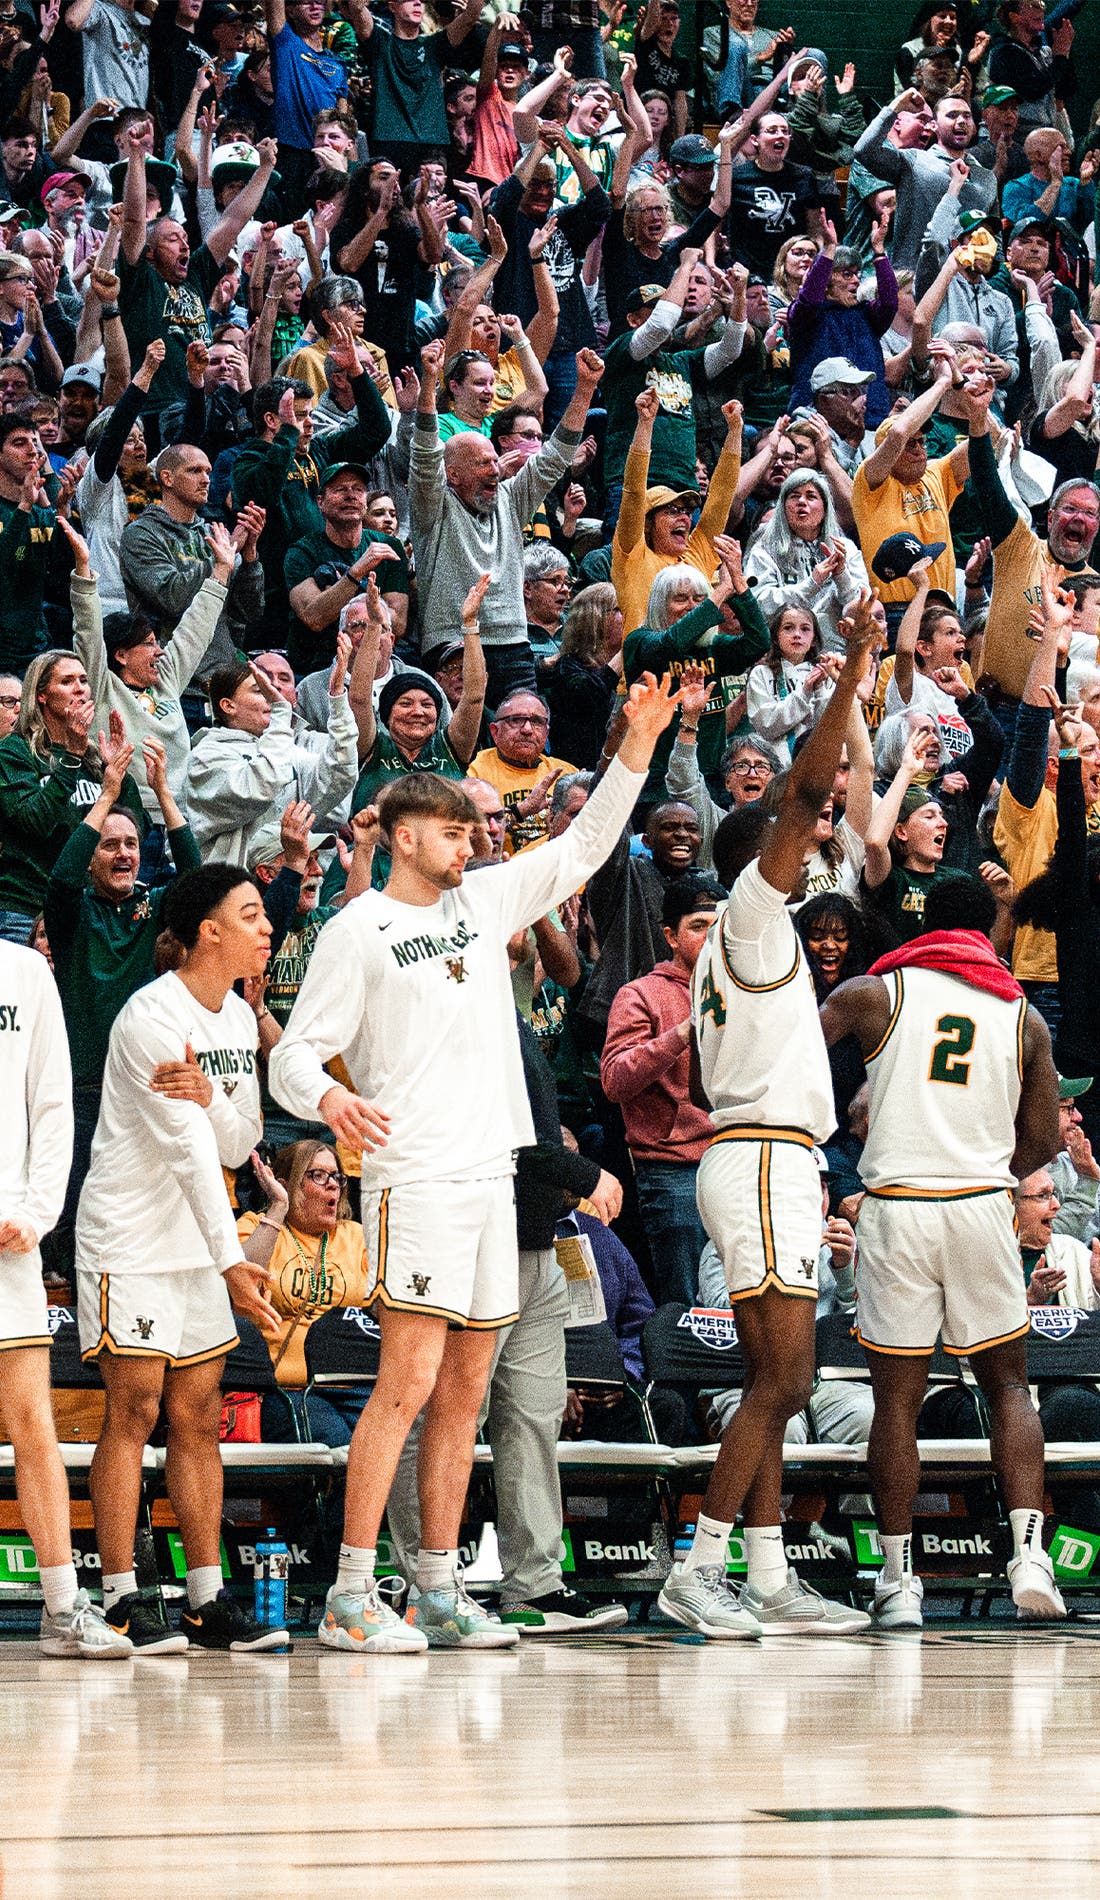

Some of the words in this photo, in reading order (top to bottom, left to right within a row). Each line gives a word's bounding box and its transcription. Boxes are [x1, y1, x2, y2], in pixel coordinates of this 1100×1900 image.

[928, 1012, 976, 1088] 2
[682, 1315, 736, 1330] AMERI
[1029, 1308, 1084, 1319] MERICA
[1036, 1318, 1071, 1327] EAST
[697, 1327, 735, 1338] EAST
[584, 1541, 657, 1561] Bank
[785, 1540, 836, 1560] ank
[921, 1534, 993, 1554] Bank
[1056, 1535, 1094, 1571] TD
